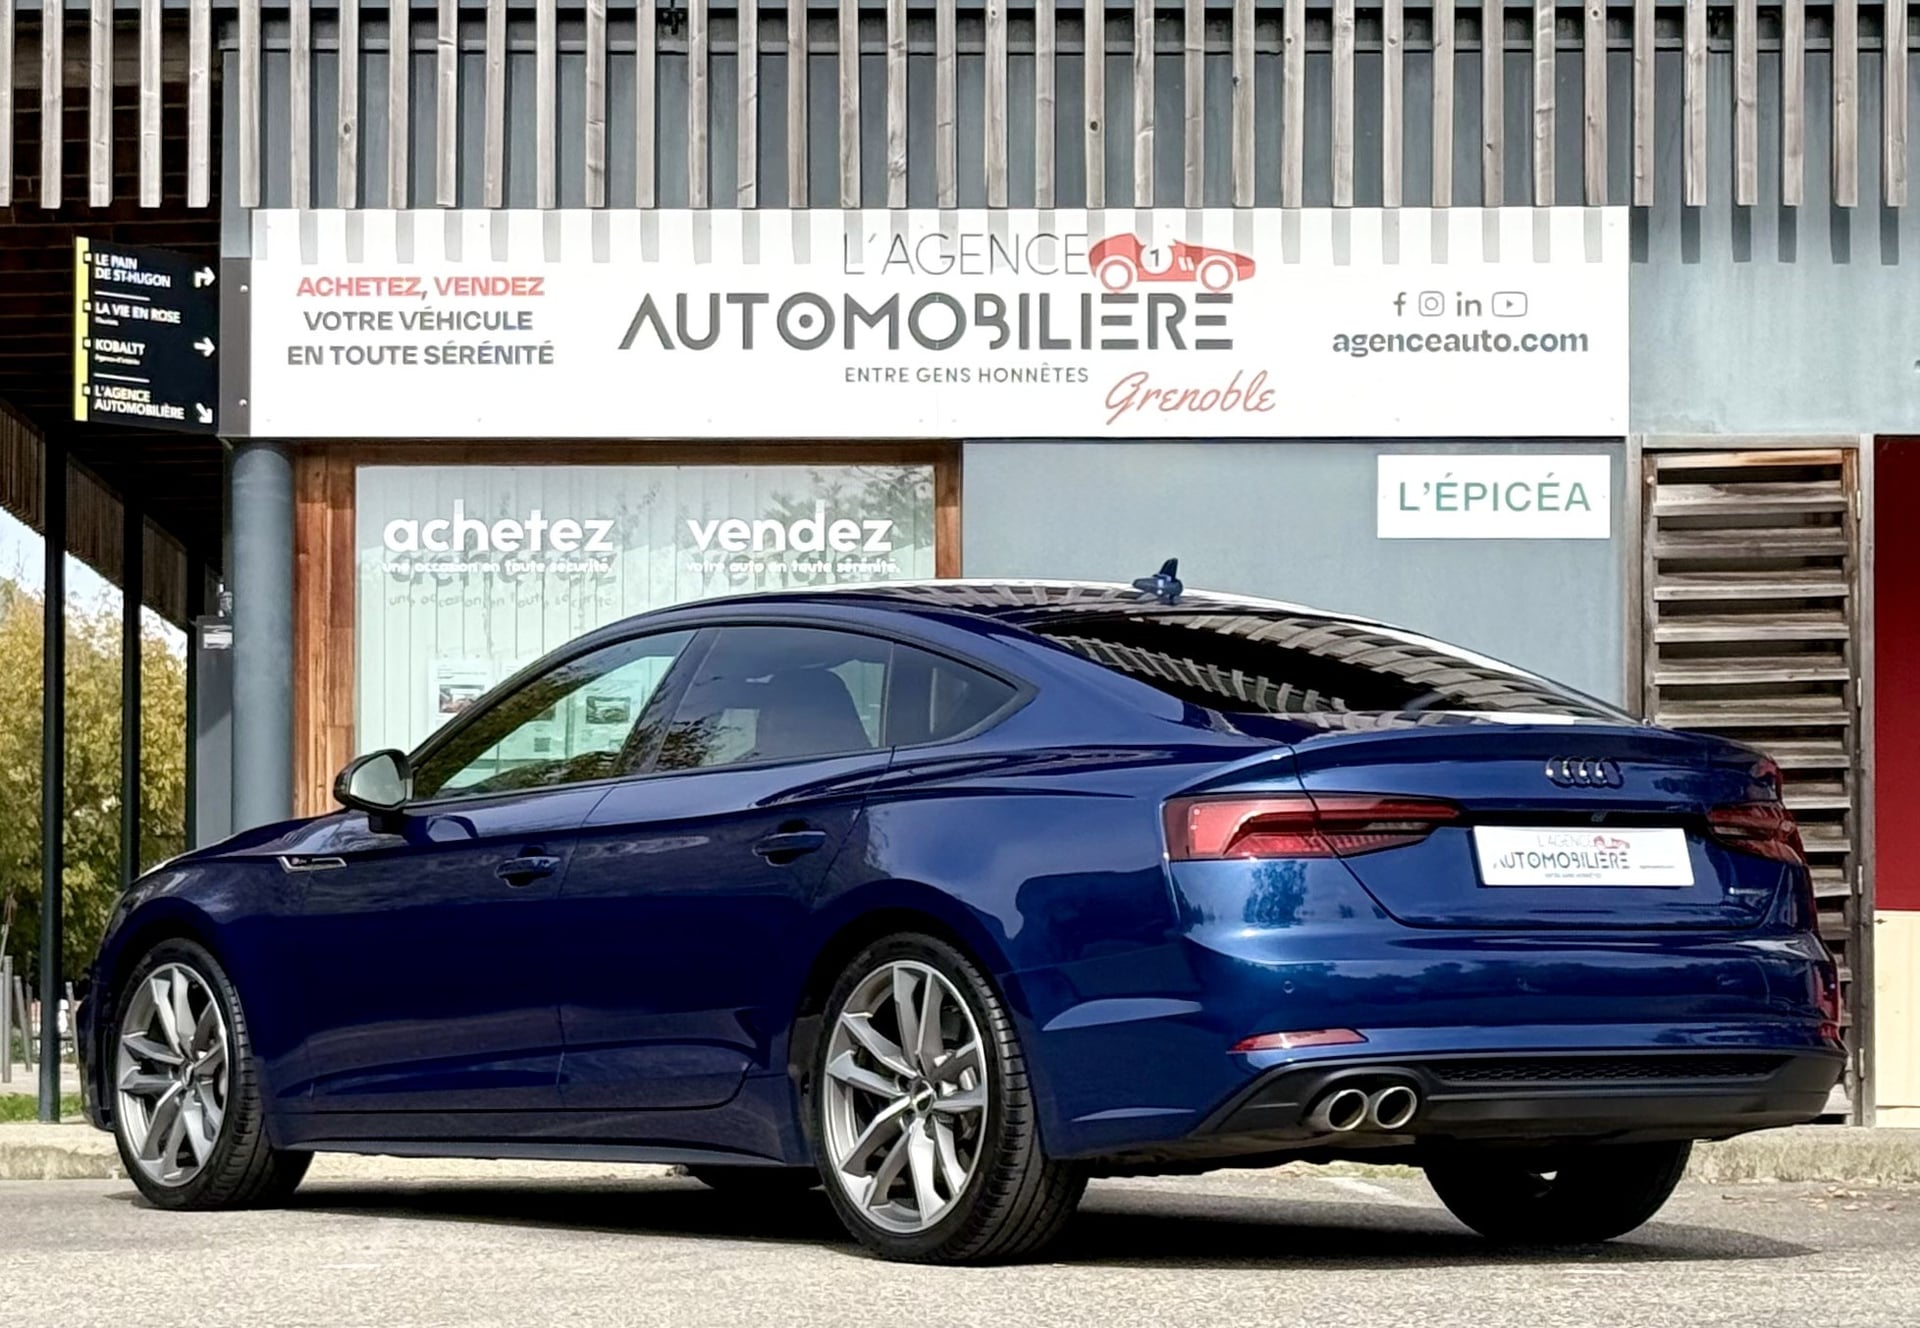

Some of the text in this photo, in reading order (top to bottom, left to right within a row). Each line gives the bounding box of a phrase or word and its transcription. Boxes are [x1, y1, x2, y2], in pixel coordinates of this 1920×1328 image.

[94, 253, 138, 270] LE PAIN
[842, 231, 1089, 276] L'AGENCE
[1149, 248, 1161, 268] 1
[94, 266, 171, 288] DE ST-HUGON
[296, 276, 545, 300] ACHETEZ, VENDEZ
[95, 301, 181, 324] LA VIE EN ROSE
[303, 305, 533, 331] VOTRE VÉHICULE
[617, 291, 1234, 351] AUTOMOBILIERE
[287, 340, 555, 366] EN TOUTE SÉRÉNITÉ
[1332, 329, 1589, 358] agenceauto.com
[844, 362, 1089, 384] ENTRE GENS HONNÊTES
[94, 384, 151, 403] L'AGENCE
[1104, 369, 1277, 426] Grenoble
[94, 398, 185, 420] AUTOMOBILIÈRE
[1399, 472, 1592, 513] L'ÉPICÉA
[383, 498, 616, 553] achetez
[687, 499, 893, 553] vendez
[414, 559, 478, 574] occasion
[687, 560, 725, 574] votre
[729, 560, 765, 574] auto
